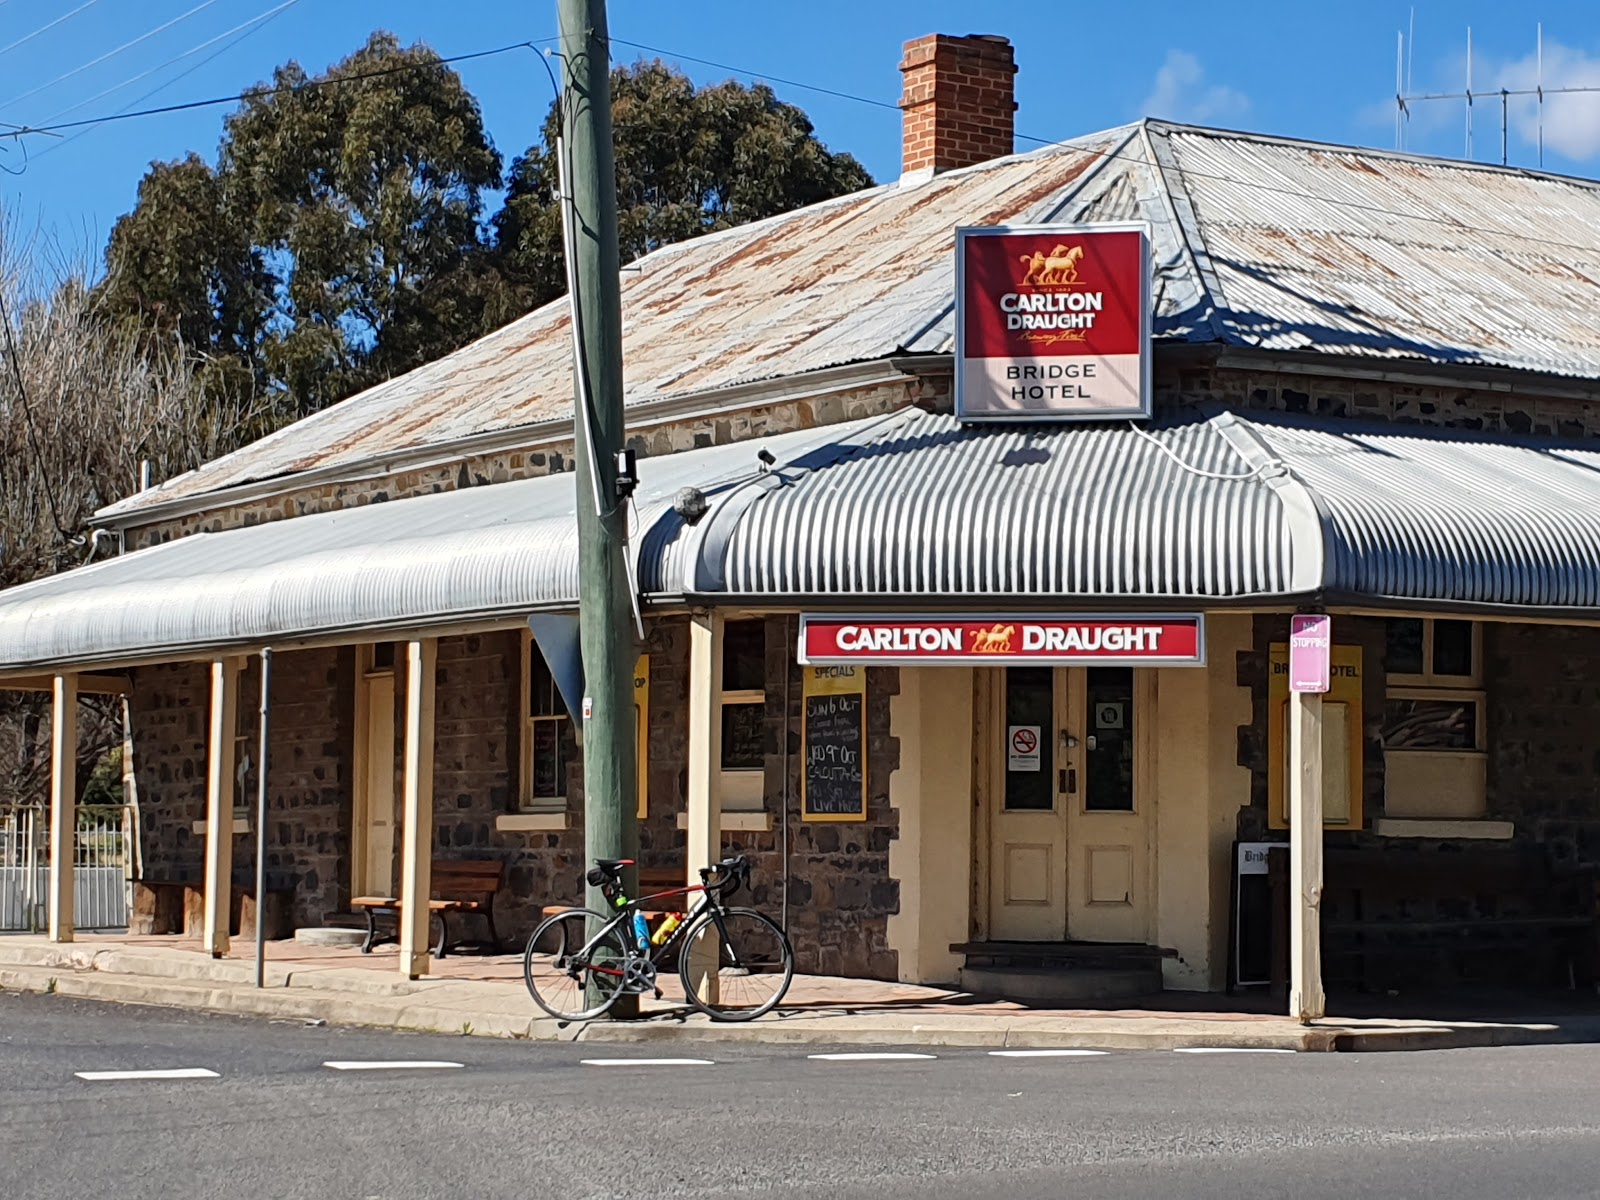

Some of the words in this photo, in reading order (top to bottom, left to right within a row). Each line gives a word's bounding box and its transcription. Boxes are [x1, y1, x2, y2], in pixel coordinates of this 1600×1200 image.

[1000, 292, 1102, 312] CARLTON
[1007, 313, 1095, 329] DRAUGHT
[1007, 363, 1096, 379] BRIDGE
[1011, 385, 1091, 400] HOTEL
[1303, 622, 1317, 632] NO
[835, 626, 962, 651] CARLTON
[1021, 626, 1162, 650] DRAUGHT
[1293, 637, 1327, 648] STOPPING
[815, 666, 855, 679] SPECIALS
[1330, 666, 1359, 677] OTEL
